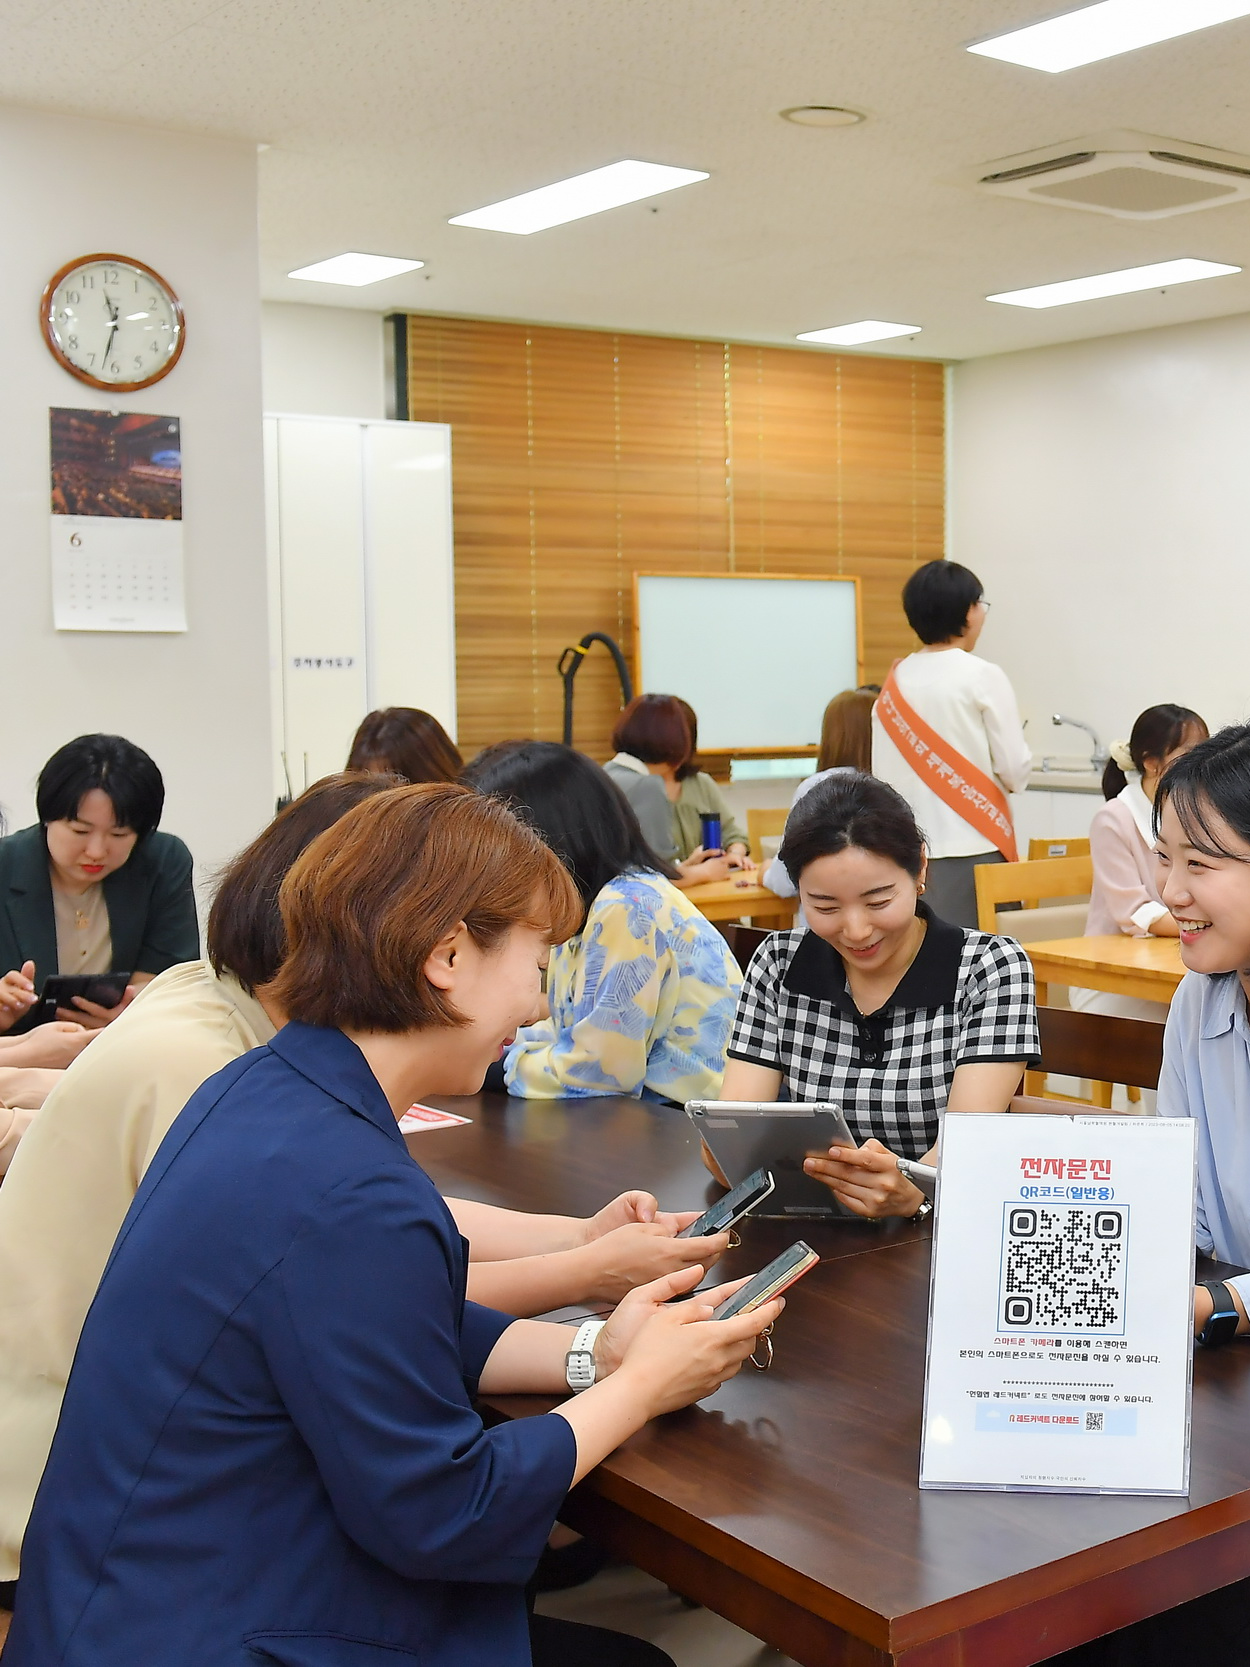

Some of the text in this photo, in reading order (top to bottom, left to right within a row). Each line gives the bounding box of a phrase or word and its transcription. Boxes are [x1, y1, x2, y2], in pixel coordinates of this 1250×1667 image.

[82, 275, 94, 289] 11
[103, 270, 118, 285] 12
[66, 291, 80, 304] 10
[149, 297, 158, 310] 2
[69, 335, 78, 349] 8
[151, 341, 158, 353] 4
[87, 353, 95, 366] 7
[134, 356, 142, 369] 5
[111, 361, 120, 373] 6
[70, 532, 82, 547] 6
[1019, 1158, 1112, 1181] 전자문진
[1020, 1186, 1115, 1201] QR코드(일반용)
[994, 1337, 1128, 1350] 스마트폰 카메라를 이용해 스캔하면
[959, 1350, 1161, 1364] 본인의 스마트폰으로도 전자문진을 하실 수 있습니다.
[1051, 1392, 1086, 1401] 전자문진에
[1089, 1393, 1111, 1402] 참여할
[1114, 1394, 1121, 1402] 수
[1124, 1394, 1154, 1403] 있습니다.
[1016, 1414, 1079, 1425] 레드커넥트 다운로드
